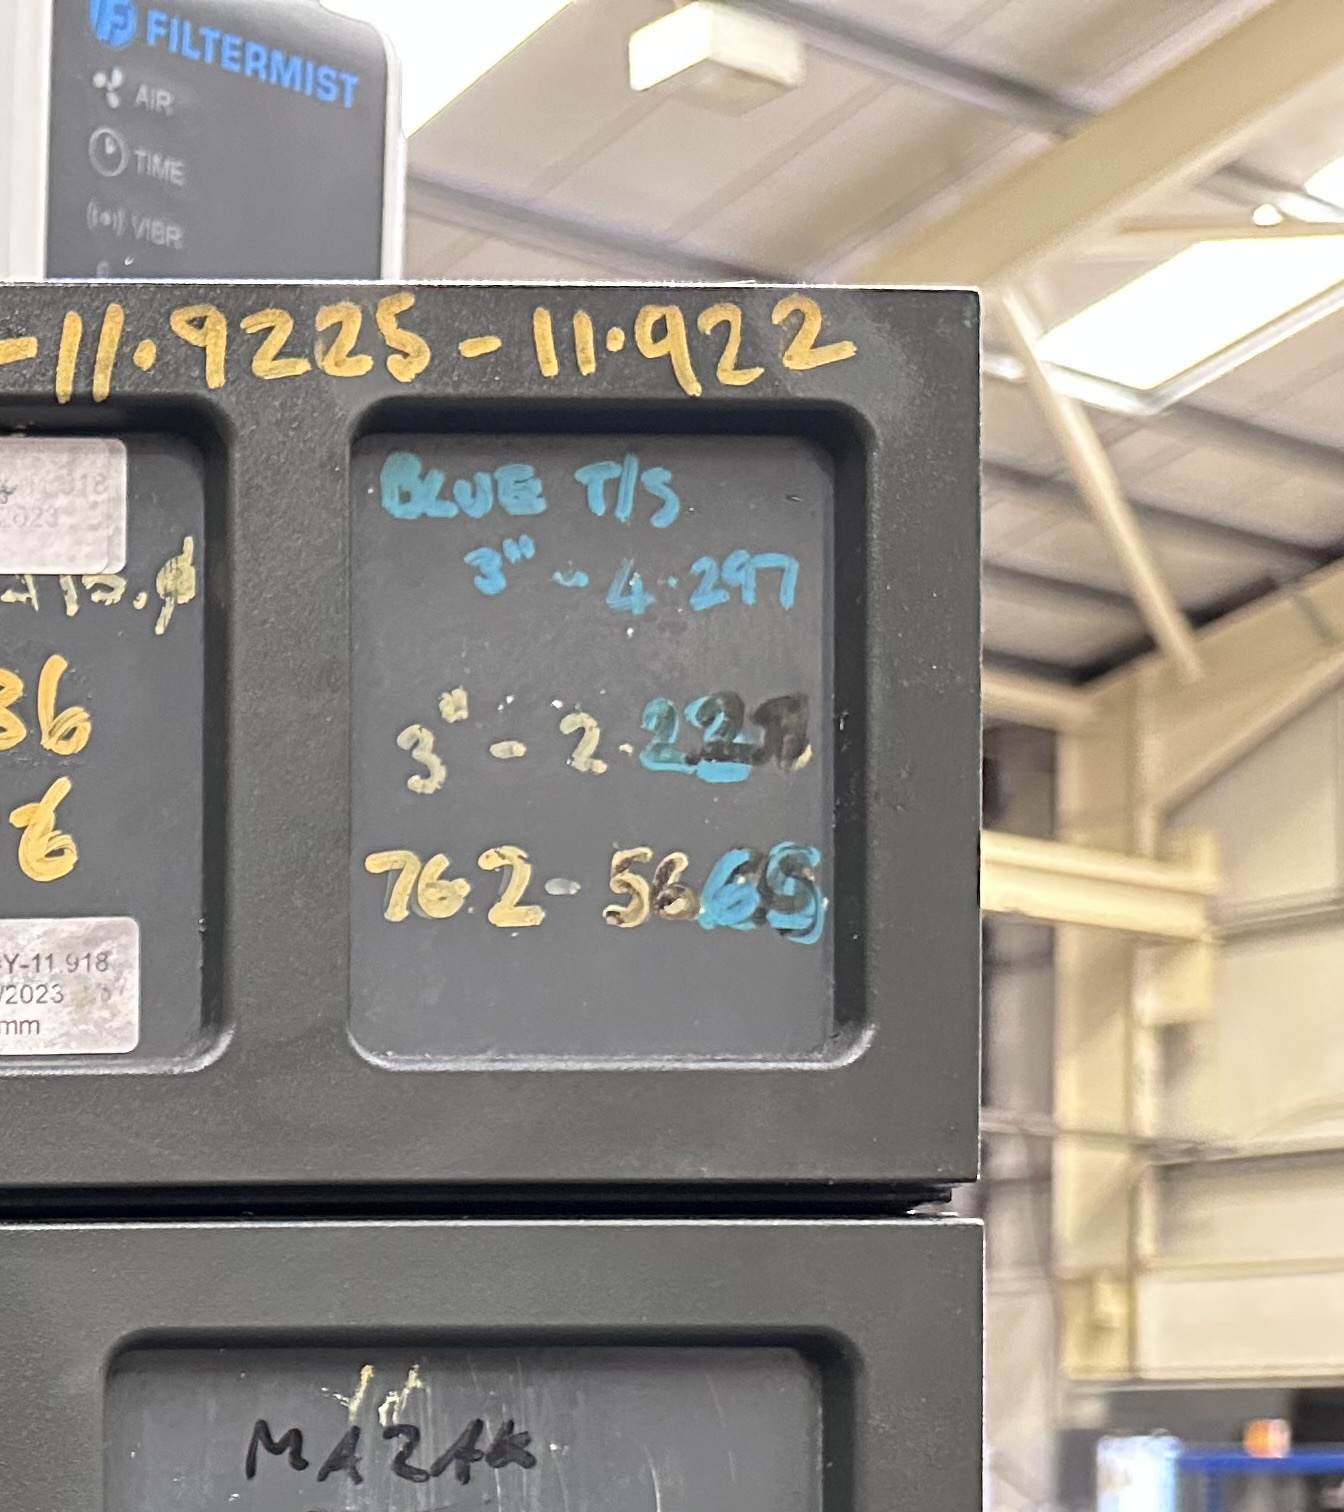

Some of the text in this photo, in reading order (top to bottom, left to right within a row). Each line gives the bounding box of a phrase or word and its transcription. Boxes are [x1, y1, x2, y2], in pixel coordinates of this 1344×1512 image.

[145, 11, 360, 108] FILTERMIST
[135, 83, 174, 115] AIR
[133, 148, 184, 187] TIME
[132, 218, 184, 248] VIBR
[380, 451, 680, 528] BLUE T/S
